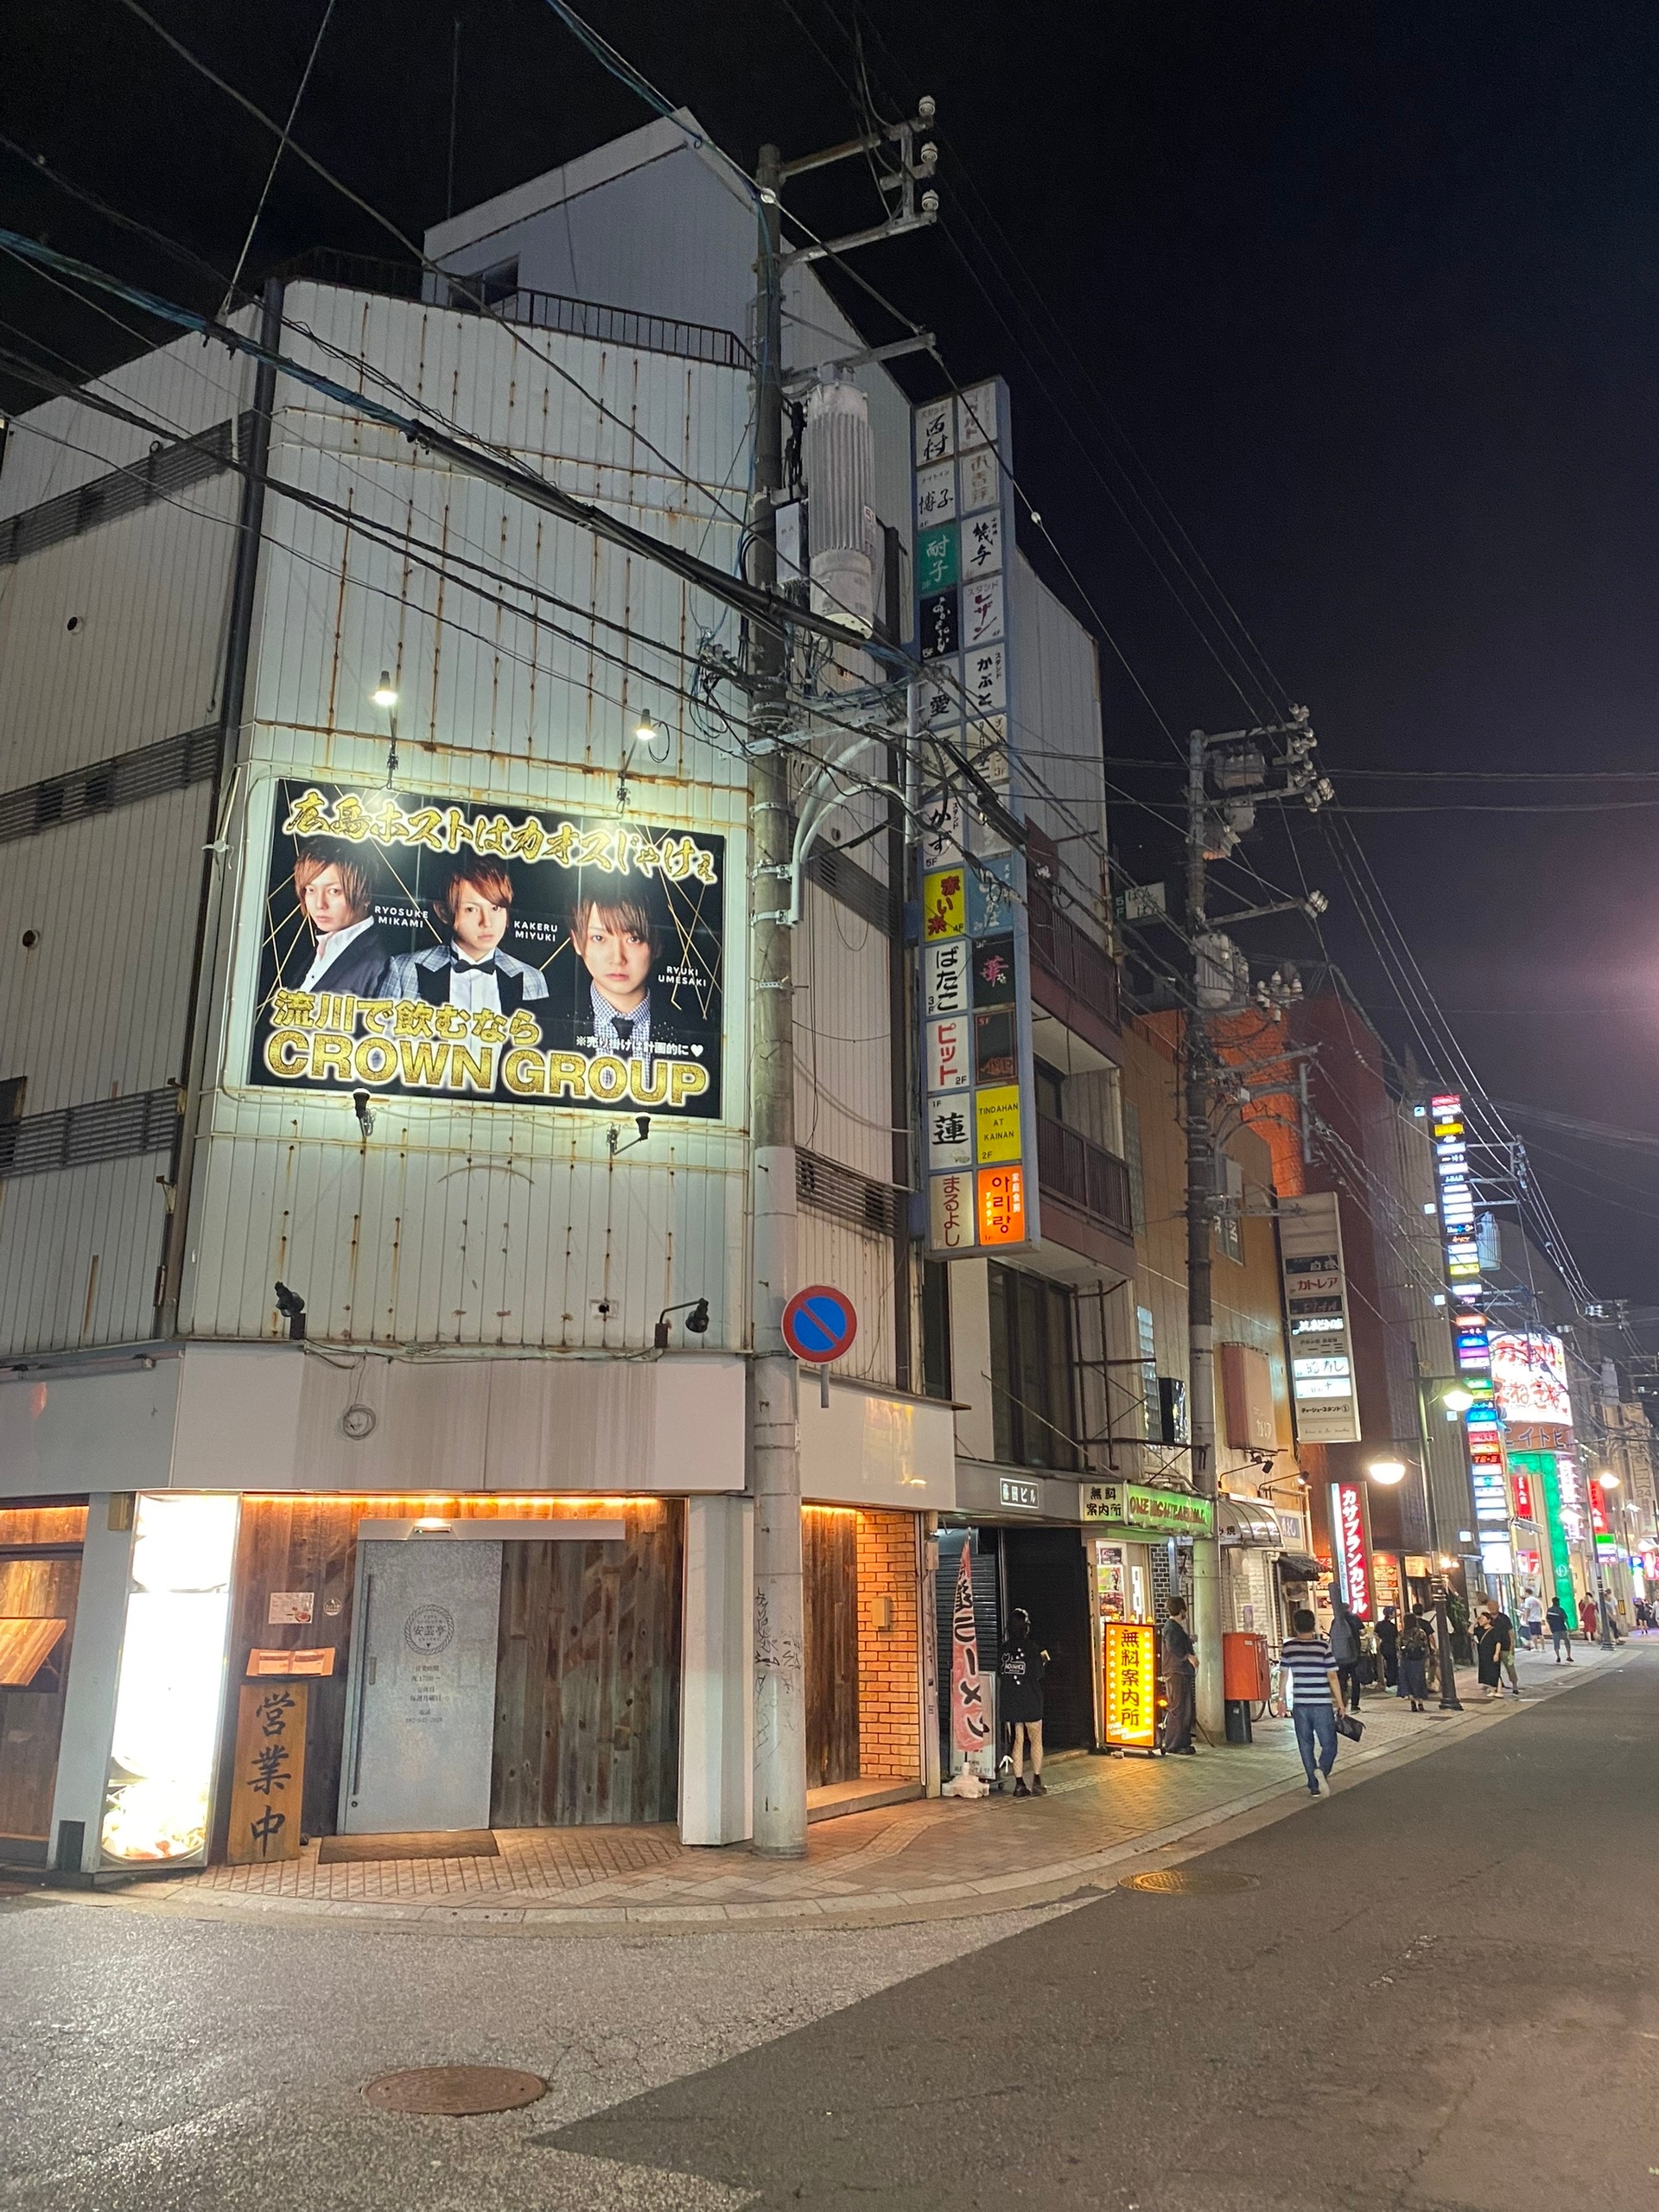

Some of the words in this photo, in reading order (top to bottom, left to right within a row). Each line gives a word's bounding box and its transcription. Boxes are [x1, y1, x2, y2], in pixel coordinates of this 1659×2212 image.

[924, 413, 948, 461] 西村
[967, 582, 999, 596] スタンド
[922, 646, 934, 658] 5F
[930, 695, 950, 718] 愛
[283, 788, 719, 886] 広島ホストはカオスじゃけぇ
[926, 857, 938, 868] 5F
[374, 905, 429, 920] RYOSUKE
[378, 914, 425, 929] MIKAMI
[513, 920, 559, 933] KAKERU
[514, 930, 557, 943] MIYUKI
[666, 965, 699, 978] RYUKI
[658, 974, 708, 988] UMESAKI
[271, 987, 543, 1047] 流川で飲むなら
[264, 1027, 499, 1096] CROWN
[501, 1047, 710, 1109] GROUP
[955, 1075, 967, 1085] 2F
[931, 1099, 942, 1109] 1F
[978, 1102, 1019, 1116] TINDAHAN
[931, 1111, 969, 1146] 蓮
[993, 1118, 1004, 1128] AT
[983, 1130, 1014, 1142] KAINAN
[982, 1150, 993, 1160] 2F
[943, 1175, 960, 1247] まるよし
[991, 1175, 1012, 1234] 아리랑
[1298, 1277, 1338, 1291] カトレア
[1090, 1486, 1116, 1501] 無料
[1085, 1503, 1122, 1517] 案内所
[1130, 1496, 1149, 1515] ONE
[1121, 1629, 1140, 1726] 無料案内所
[246, 1689, 296, 1857] 営業中
